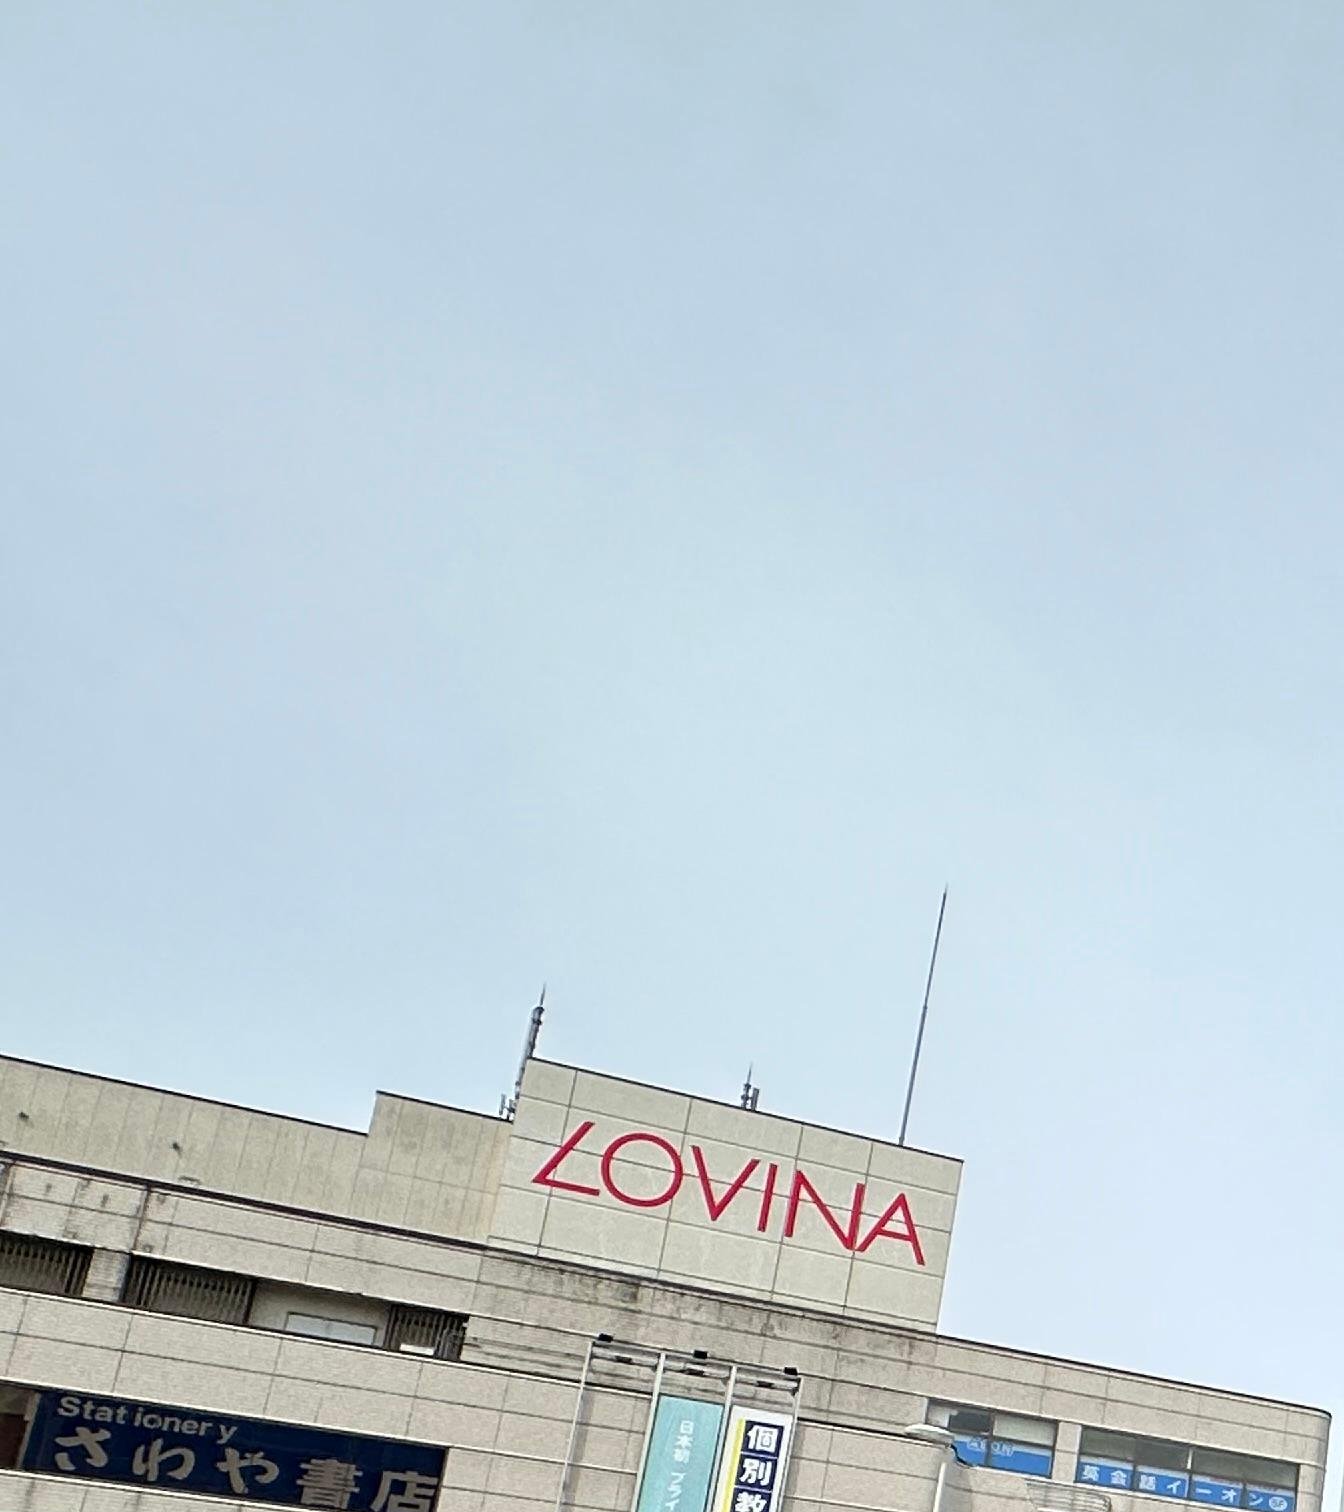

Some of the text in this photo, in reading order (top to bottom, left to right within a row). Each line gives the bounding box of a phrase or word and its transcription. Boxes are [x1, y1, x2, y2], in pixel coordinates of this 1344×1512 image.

[532, 1121, 925, 1266] LOVINA
[57, 1396, 239, 1445] Stationery
[1081, 1465, 1264, 1507] 英会話イーオン
